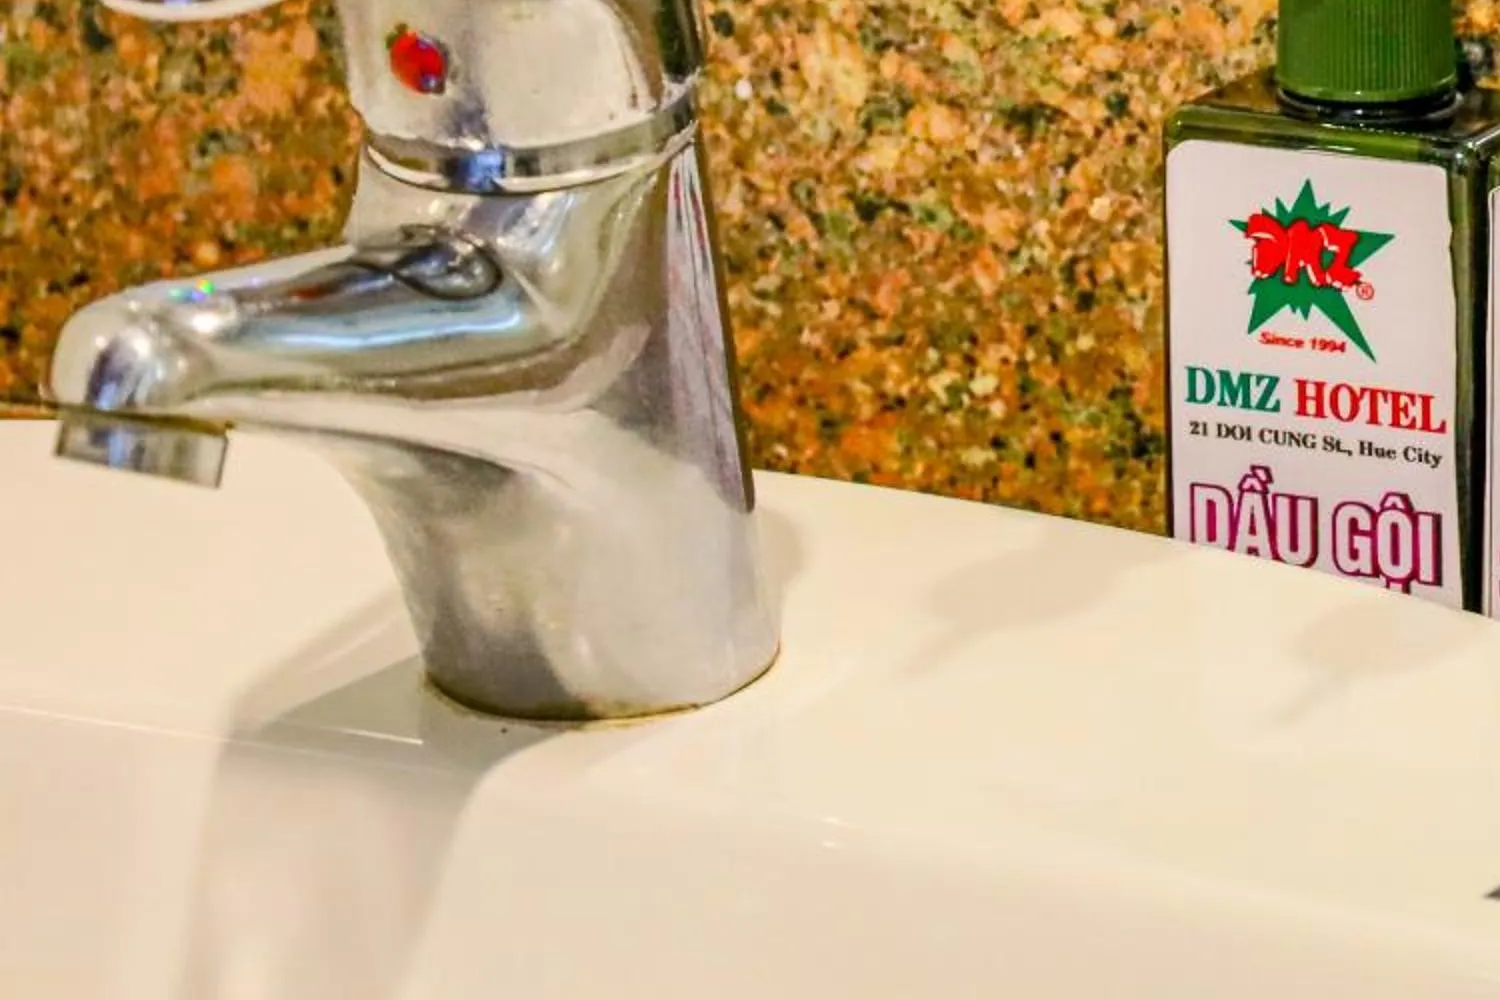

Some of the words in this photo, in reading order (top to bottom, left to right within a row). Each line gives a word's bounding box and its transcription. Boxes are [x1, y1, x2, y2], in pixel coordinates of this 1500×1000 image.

[1258, 331, 1304, 350] Since
[1310, 337, 1347, 354] 1994
[1184, 366, 1281, 412] DMZ
[1293, 379, 1447, 434] HOTEL
[1189, 421, 1208, 436] 21
[1216, 423, 1252, 441] DOI
[1258, 429, 1317, 449] CUNG
[1322, 435, 1353, 457] St.,
[1359, 441, 1396, 460] Hue
[1403, 446, 1442, 469] City
